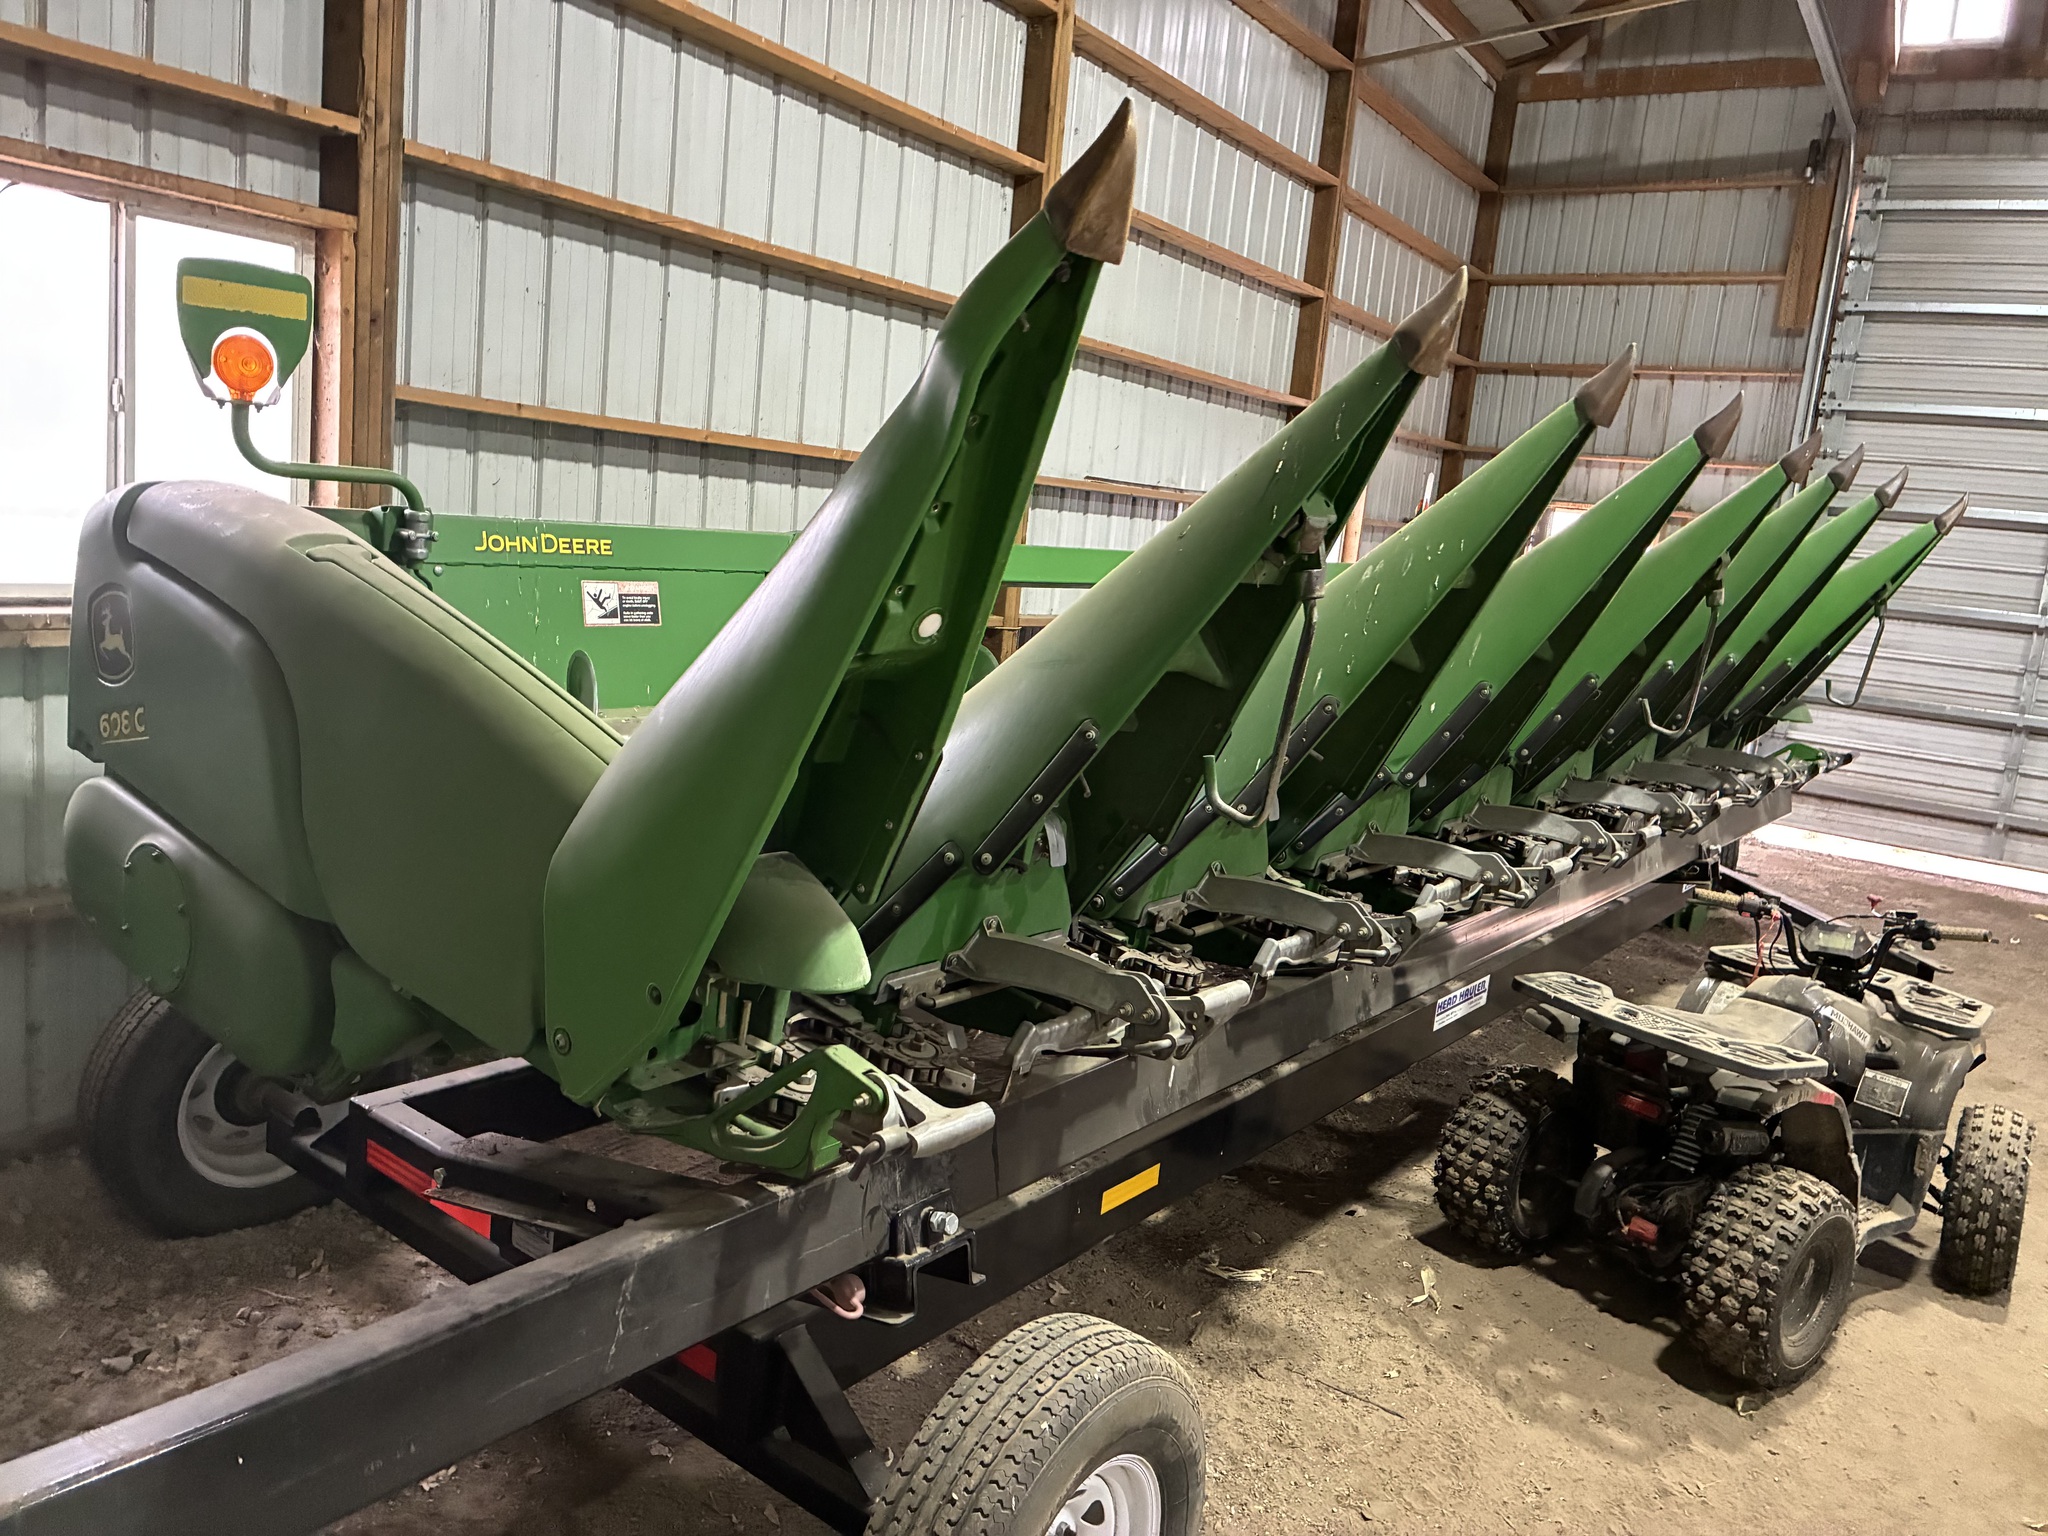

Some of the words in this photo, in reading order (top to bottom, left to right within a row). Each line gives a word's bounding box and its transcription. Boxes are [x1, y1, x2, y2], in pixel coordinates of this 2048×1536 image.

[474, 530, 537, 553] JOHN
[540, 533, 613, 556] DEERE
[1437, 994, 1458, 1013] HEAD
[1459, 980, 1487, 1002] HAULER
[1830, 1009, 1868, 1042] MUDHAWK
